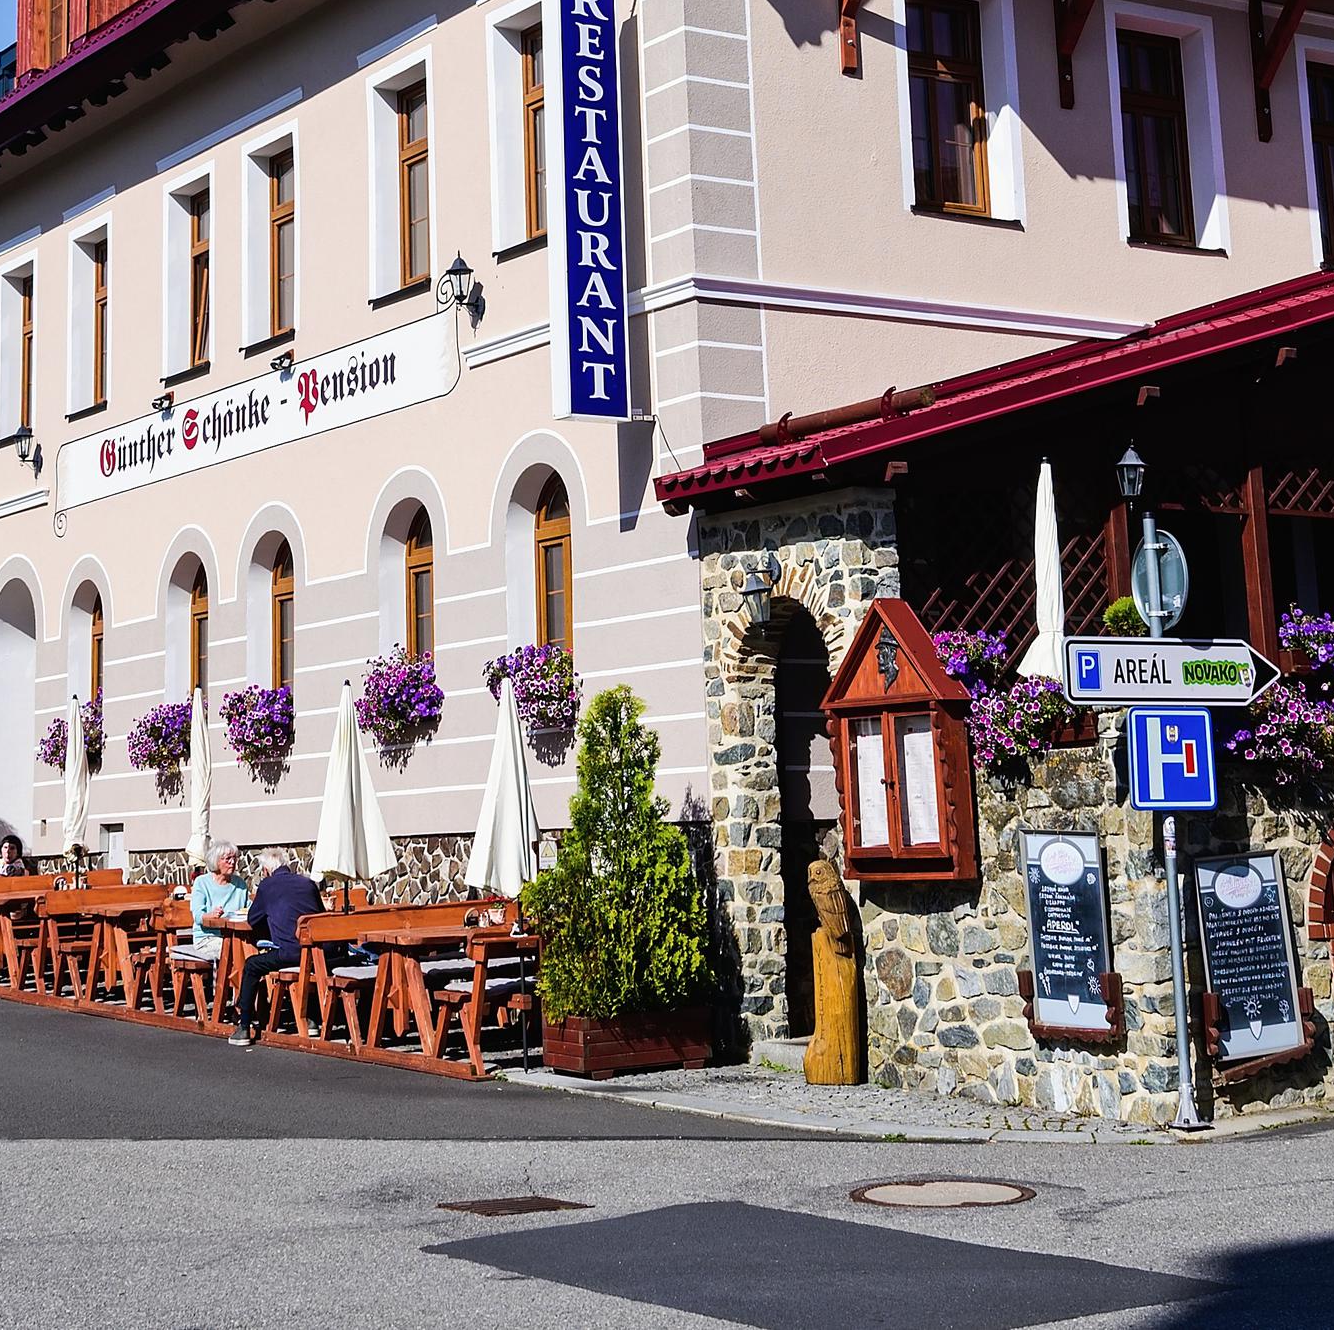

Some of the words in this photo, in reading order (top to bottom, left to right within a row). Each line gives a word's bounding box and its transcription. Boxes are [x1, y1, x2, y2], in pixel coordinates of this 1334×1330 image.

[99, 423, 175, 478] Günther
[181, 388, 270, 454] Schänke
[297, 351, 396, 426] Pension
[1114, 653, 1172, 684] AREÁL
